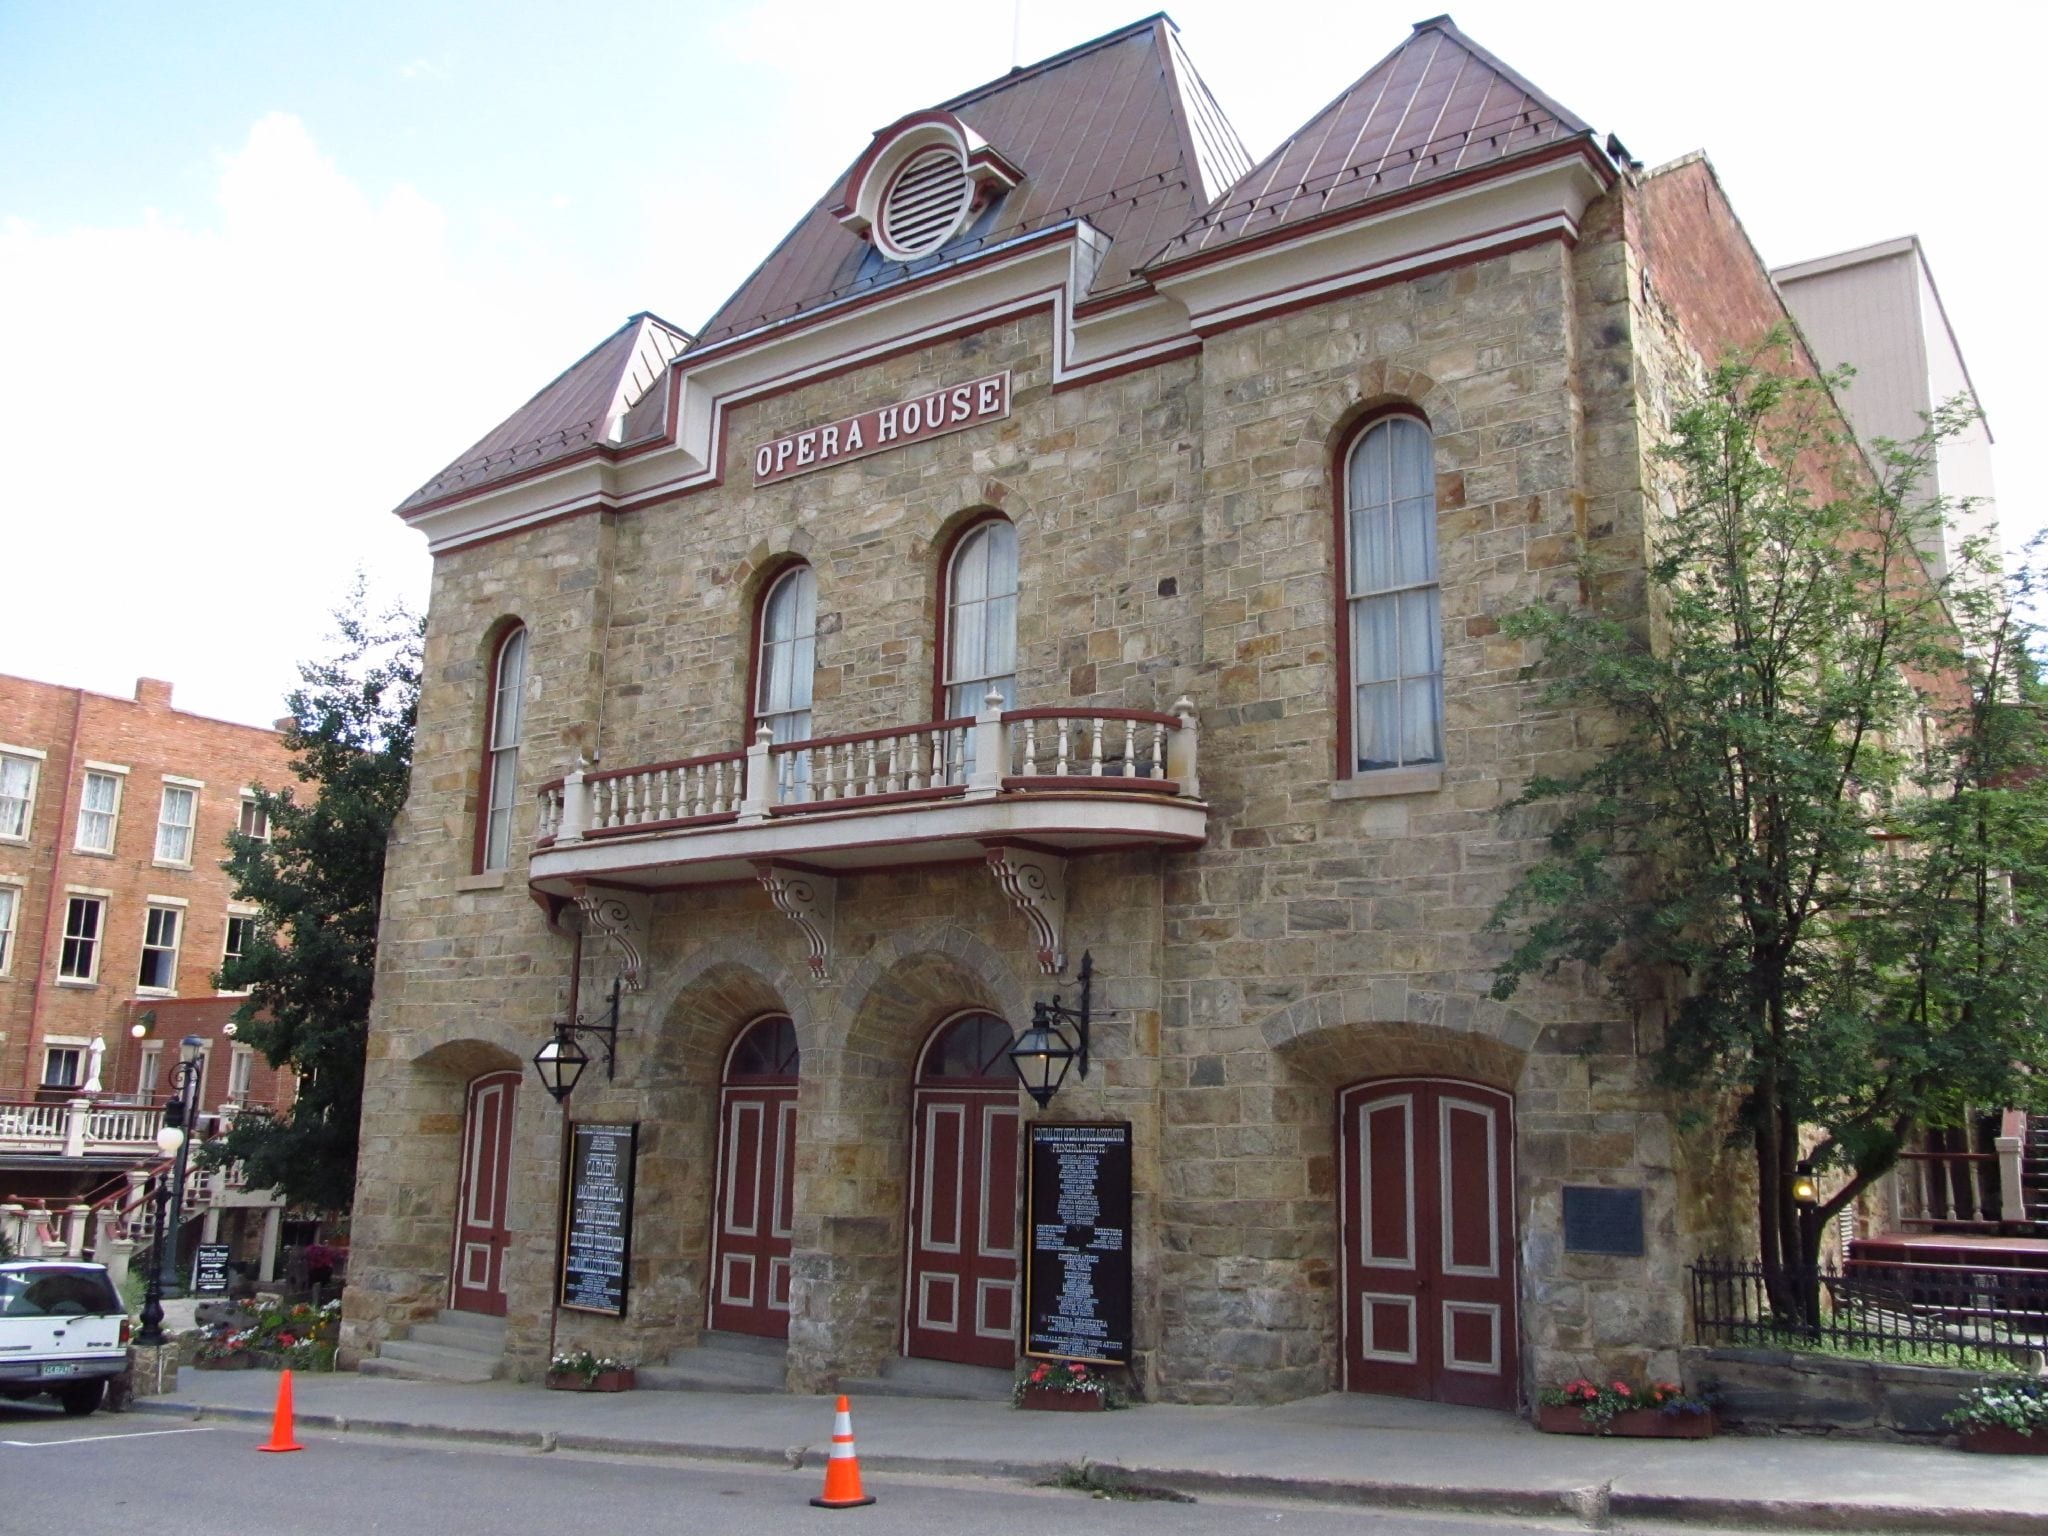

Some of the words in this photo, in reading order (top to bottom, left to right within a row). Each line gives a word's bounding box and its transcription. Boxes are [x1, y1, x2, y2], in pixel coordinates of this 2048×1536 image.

[756, 419, 864, 478] OPERA
[877, 378, 1001, 444] HOUSE
[1064, 1128, 1079, 1141] OPERA
[1052, 1143, 1082, 1153] PRINCIPAL
[1083, 1144, 1106, 1153] ARTISTS
[586, 1161, 617, 1177] CARMEN
